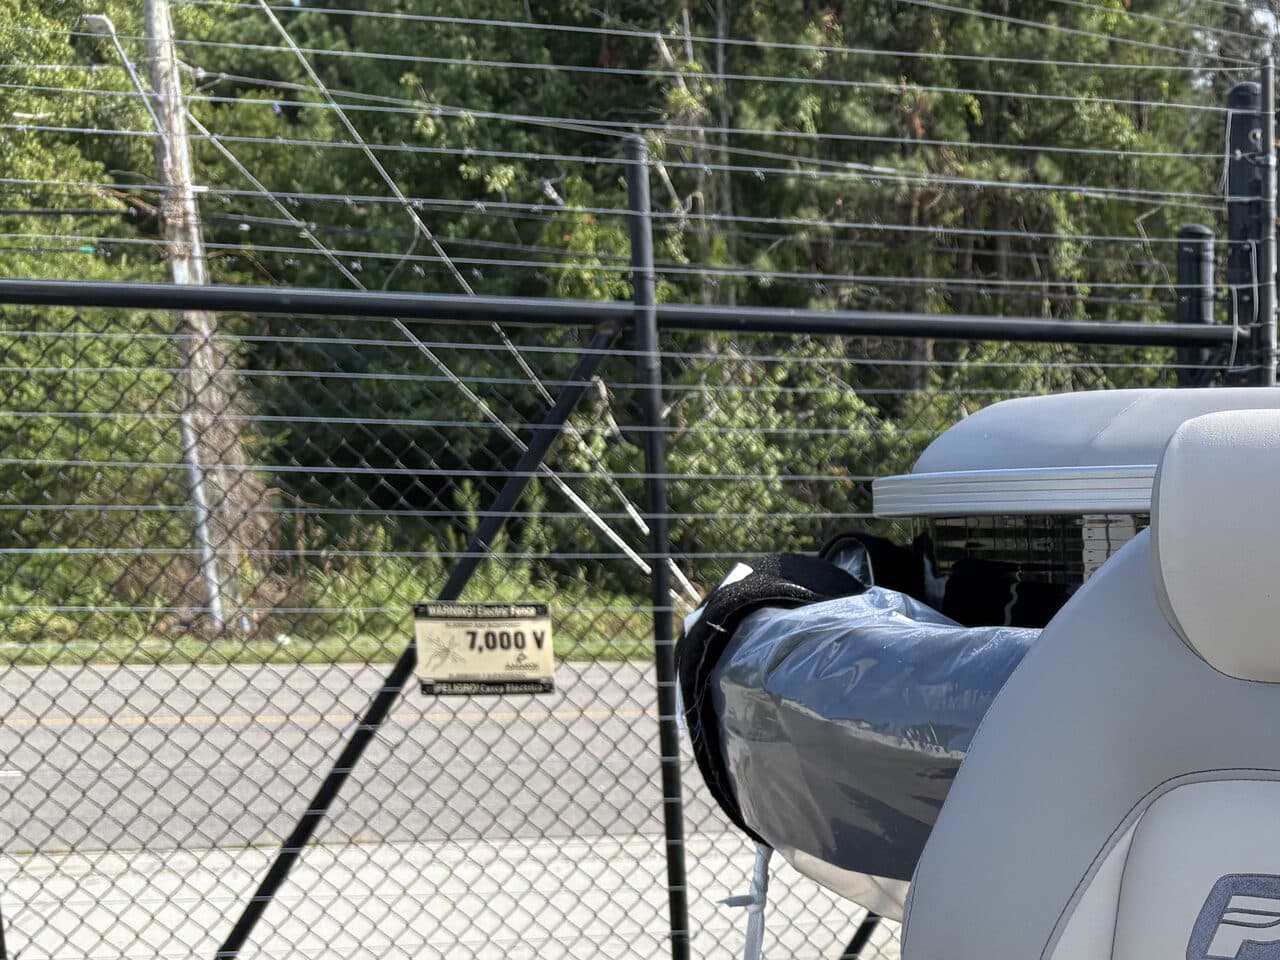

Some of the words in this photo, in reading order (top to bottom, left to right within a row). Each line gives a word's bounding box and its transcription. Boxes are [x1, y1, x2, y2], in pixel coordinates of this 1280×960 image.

[428, 605, 475, 616] WARNING!
[477, 605, 509, 616] Electric
[510, 605, 537, 616] Fence
[466, 631, 526, 652] 7,000
[533, 631, 545, 649] V
